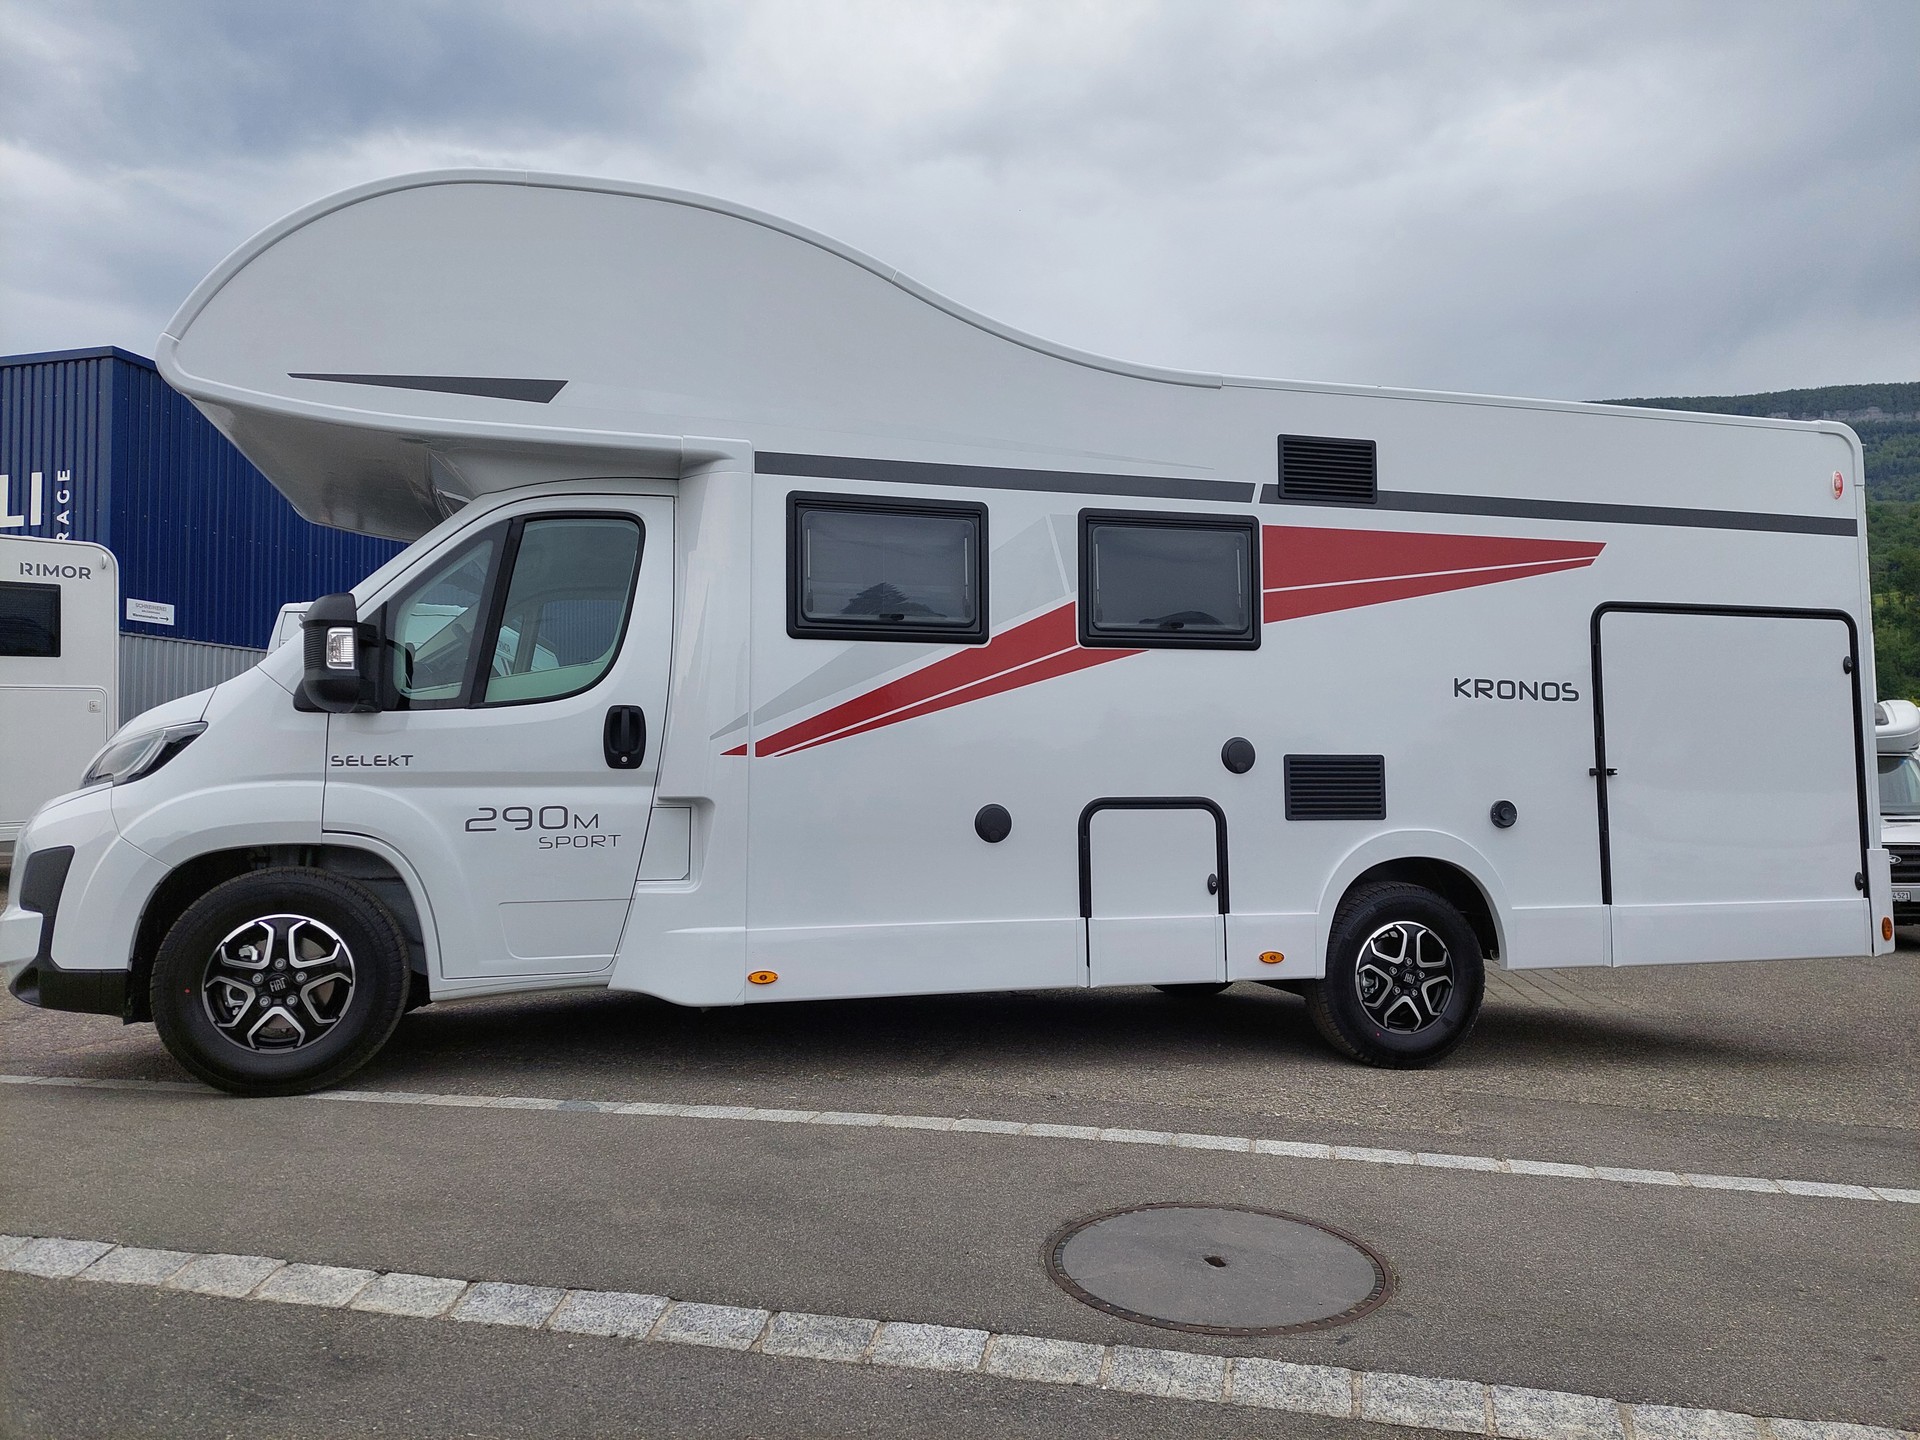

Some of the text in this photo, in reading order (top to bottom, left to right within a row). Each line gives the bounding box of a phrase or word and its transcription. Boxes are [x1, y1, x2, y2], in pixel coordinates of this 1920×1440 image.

[20, 562, 91, 580] RIMOR
[1454, 677, 1579, 701] KRONOS
[538, 834, 621, 849] SPORT
[269, 977, 286, 992] FIAT
